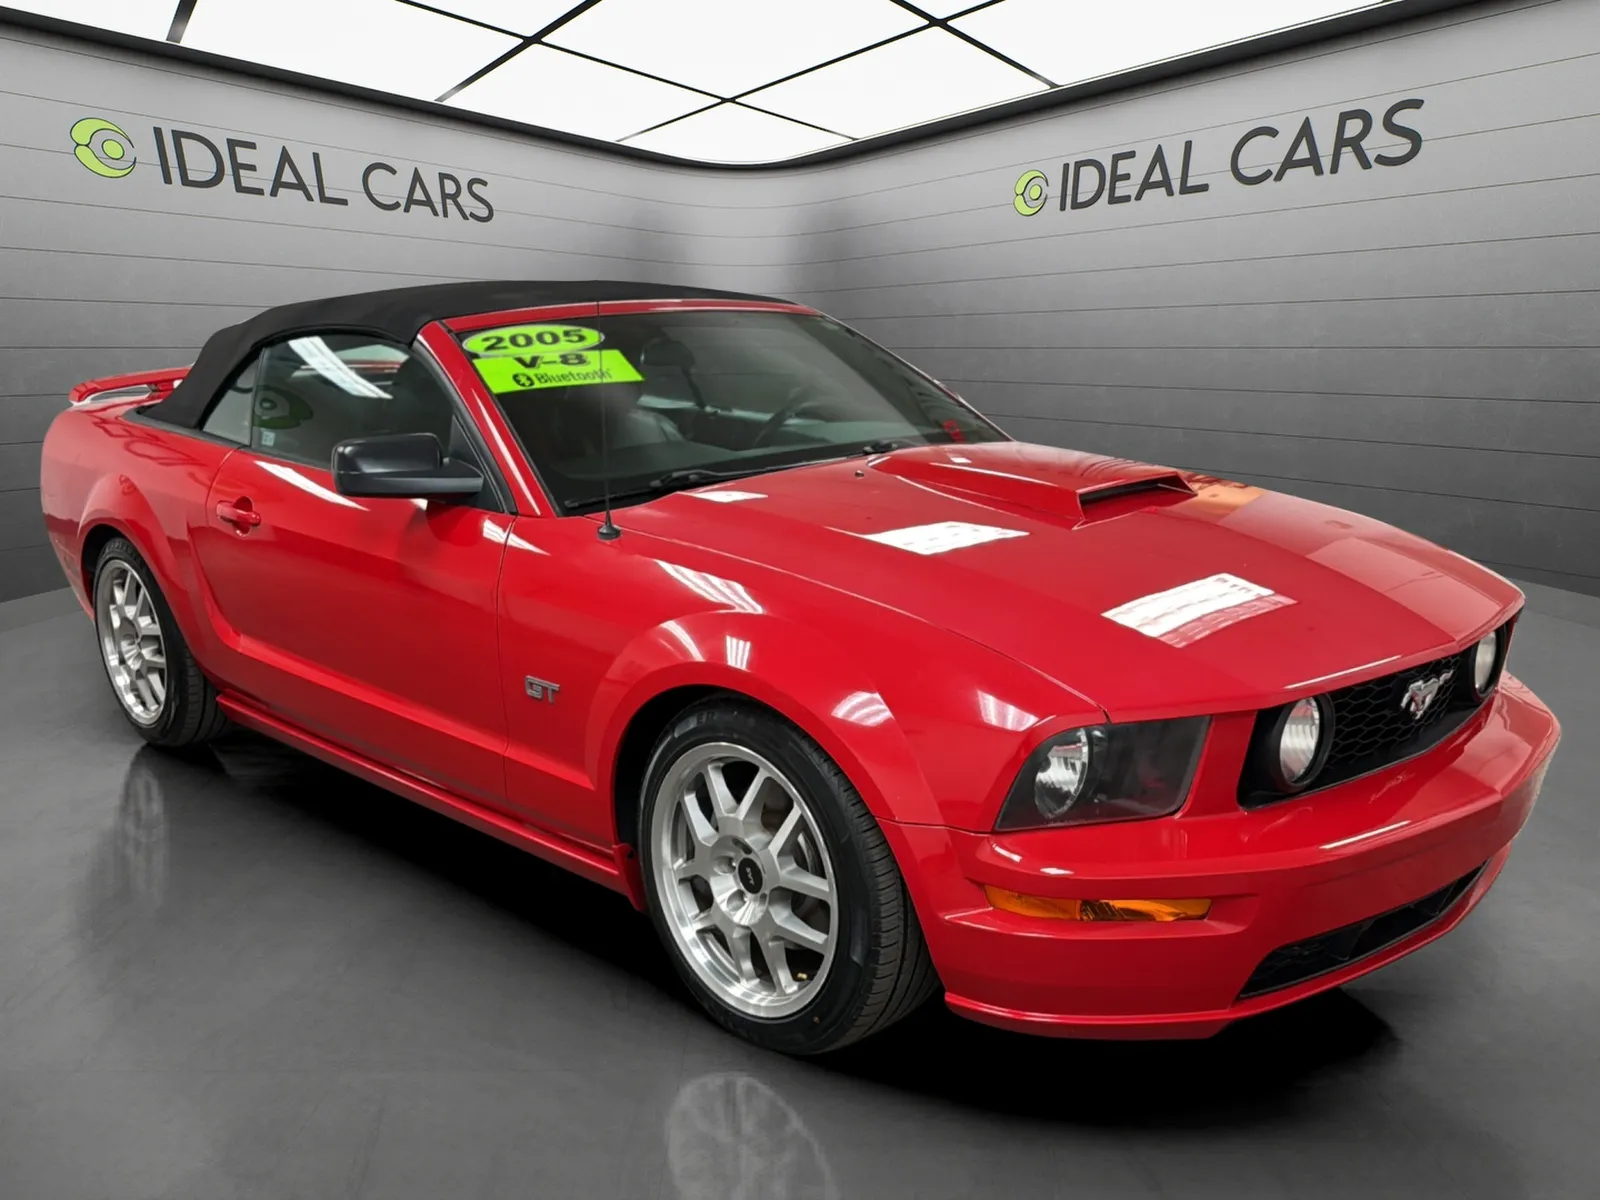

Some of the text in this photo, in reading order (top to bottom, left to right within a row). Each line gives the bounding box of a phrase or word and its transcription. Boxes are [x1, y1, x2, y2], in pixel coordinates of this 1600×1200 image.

[1059, 98, 1425, 212] IDEAL CARS
[152, 126, 495, 223] IDEAL CARS
[481, 328, 588, 351] 2005
[513, 352, 590, 369] V-8
[536, 368, 612, 385] Bluetooth
[525, 674, 561, 704] GT
